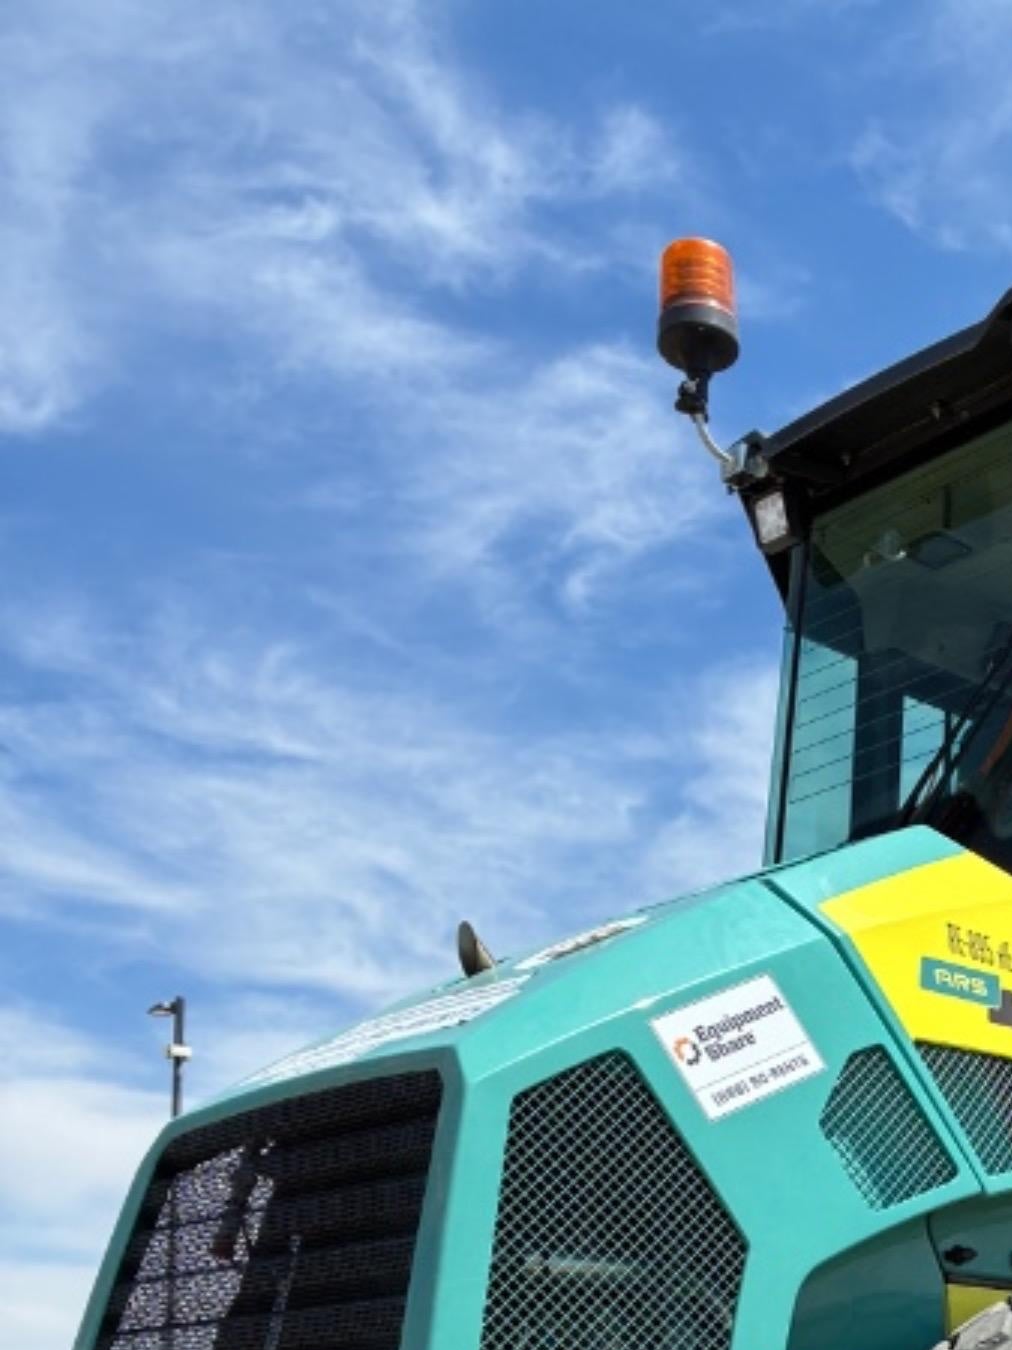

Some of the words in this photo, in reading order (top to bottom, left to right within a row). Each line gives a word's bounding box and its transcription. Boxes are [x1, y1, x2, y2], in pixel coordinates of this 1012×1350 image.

[933, 967, 989, 997] ARS
[692, 995, 785, 1043] Equipment
[704, 1030, 757, 1063] Share
